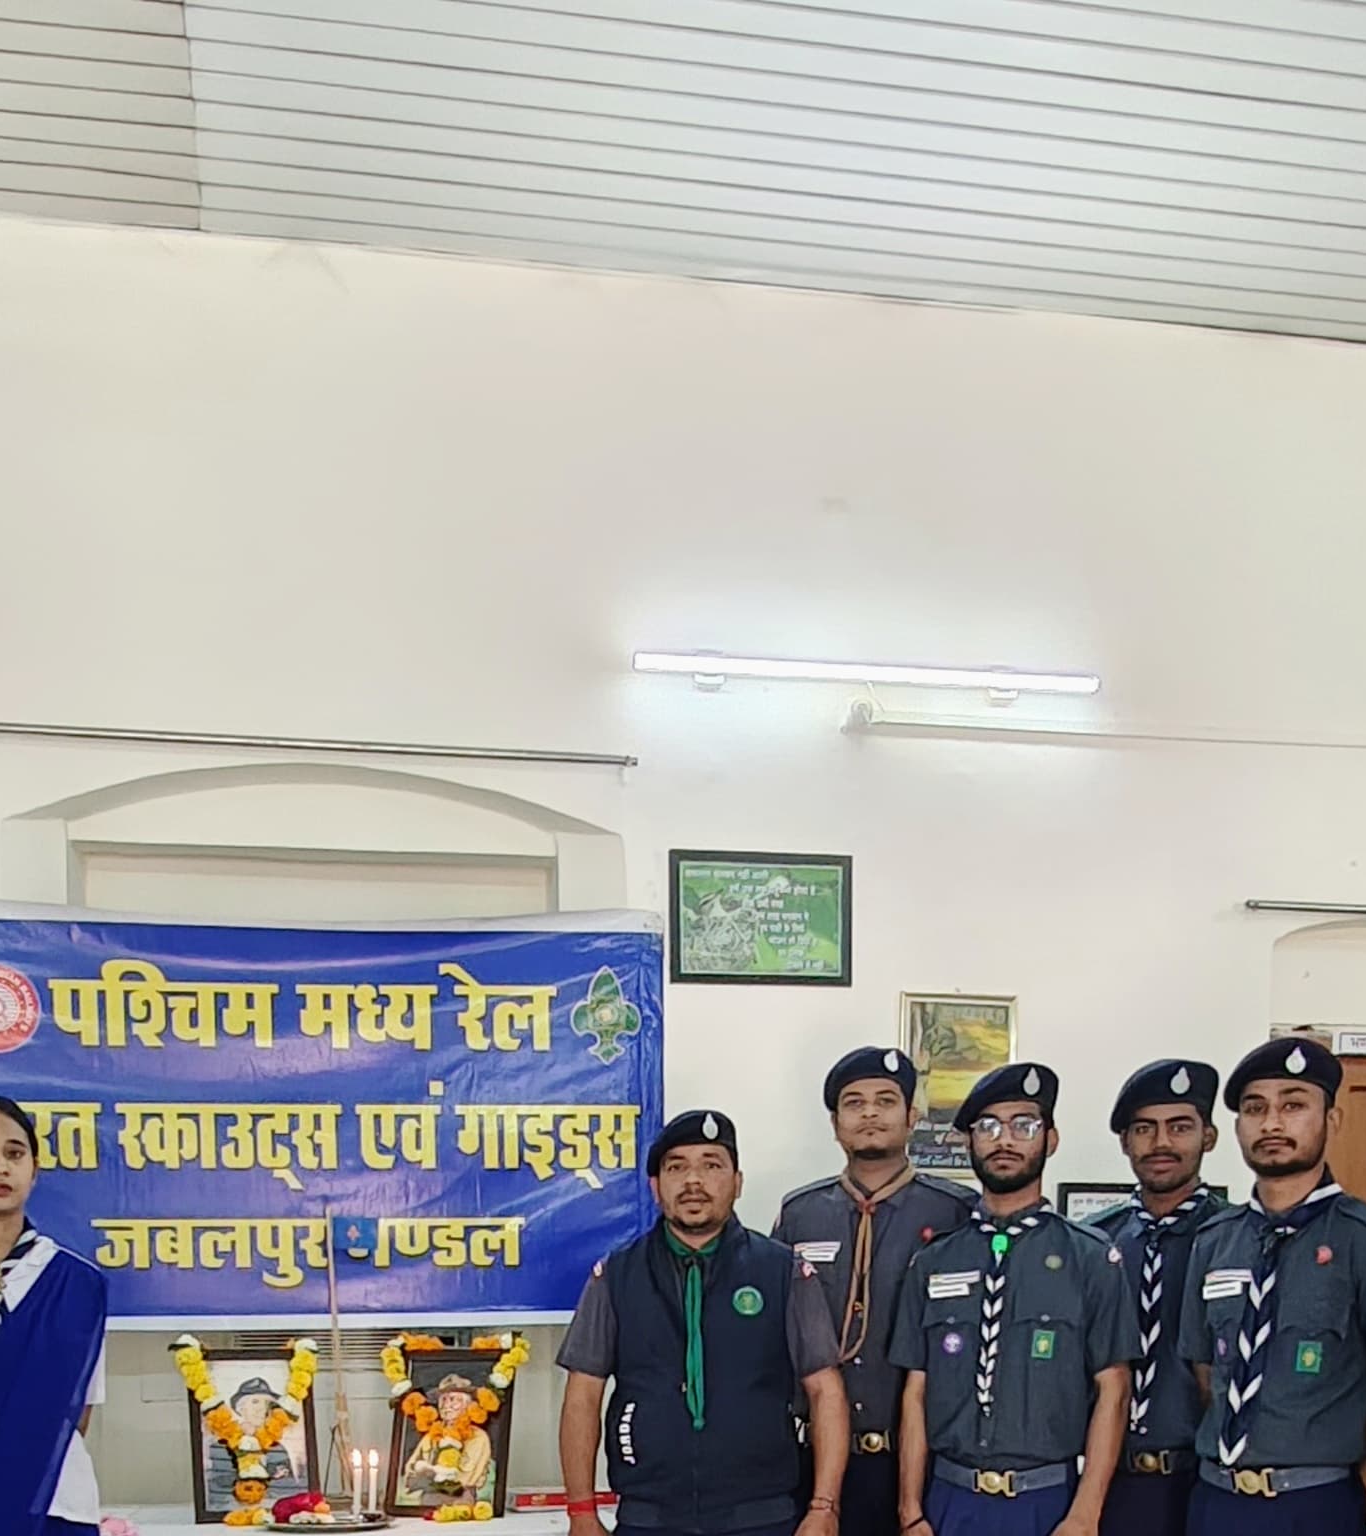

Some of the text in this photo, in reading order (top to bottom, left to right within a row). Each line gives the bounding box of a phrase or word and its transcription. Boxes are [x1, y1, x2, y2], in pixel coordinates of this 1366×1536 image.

[48, 960, 279, 1048] पश्चिम
[297, 984, 438, 1050] मध्य
[438, 963, 557, 1050] रेल
[17, 1081, 641, 1189] रत स्काउट्स एवं गाइड्स
[91, 1217, 329, 1288] जबलपुर
[618, 1402, 636, 1465] JORDAN
